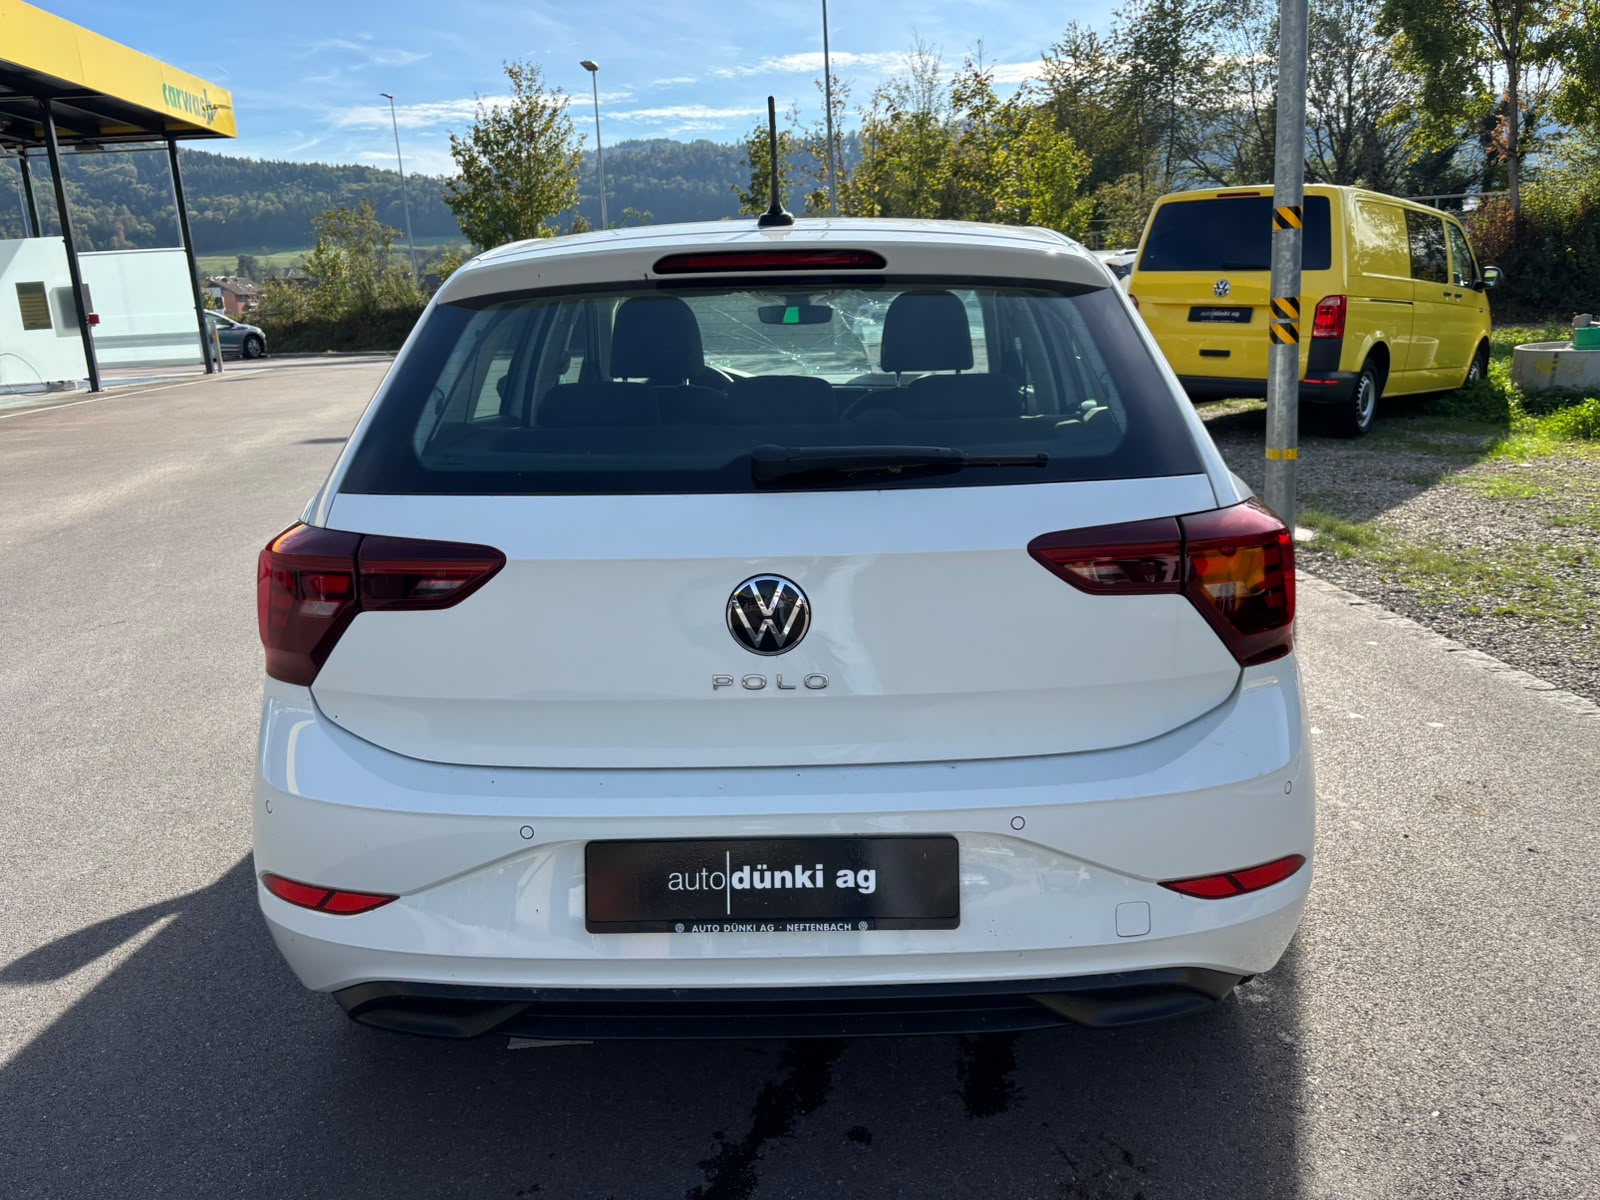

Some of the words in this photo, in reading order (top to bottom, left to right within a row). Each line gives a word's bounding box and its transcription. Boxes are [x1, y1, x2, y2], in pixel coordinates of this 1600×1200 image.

[712, 673, 829, 690] POLO
[836, 869, 876, 894] ag
[692, 925, 720, 933] AUTO
[724, 923, 756, 932] DÜNKI
[760, 924, 775, 932] AG
[787, 923, 852, 932] NEFTENBACH
